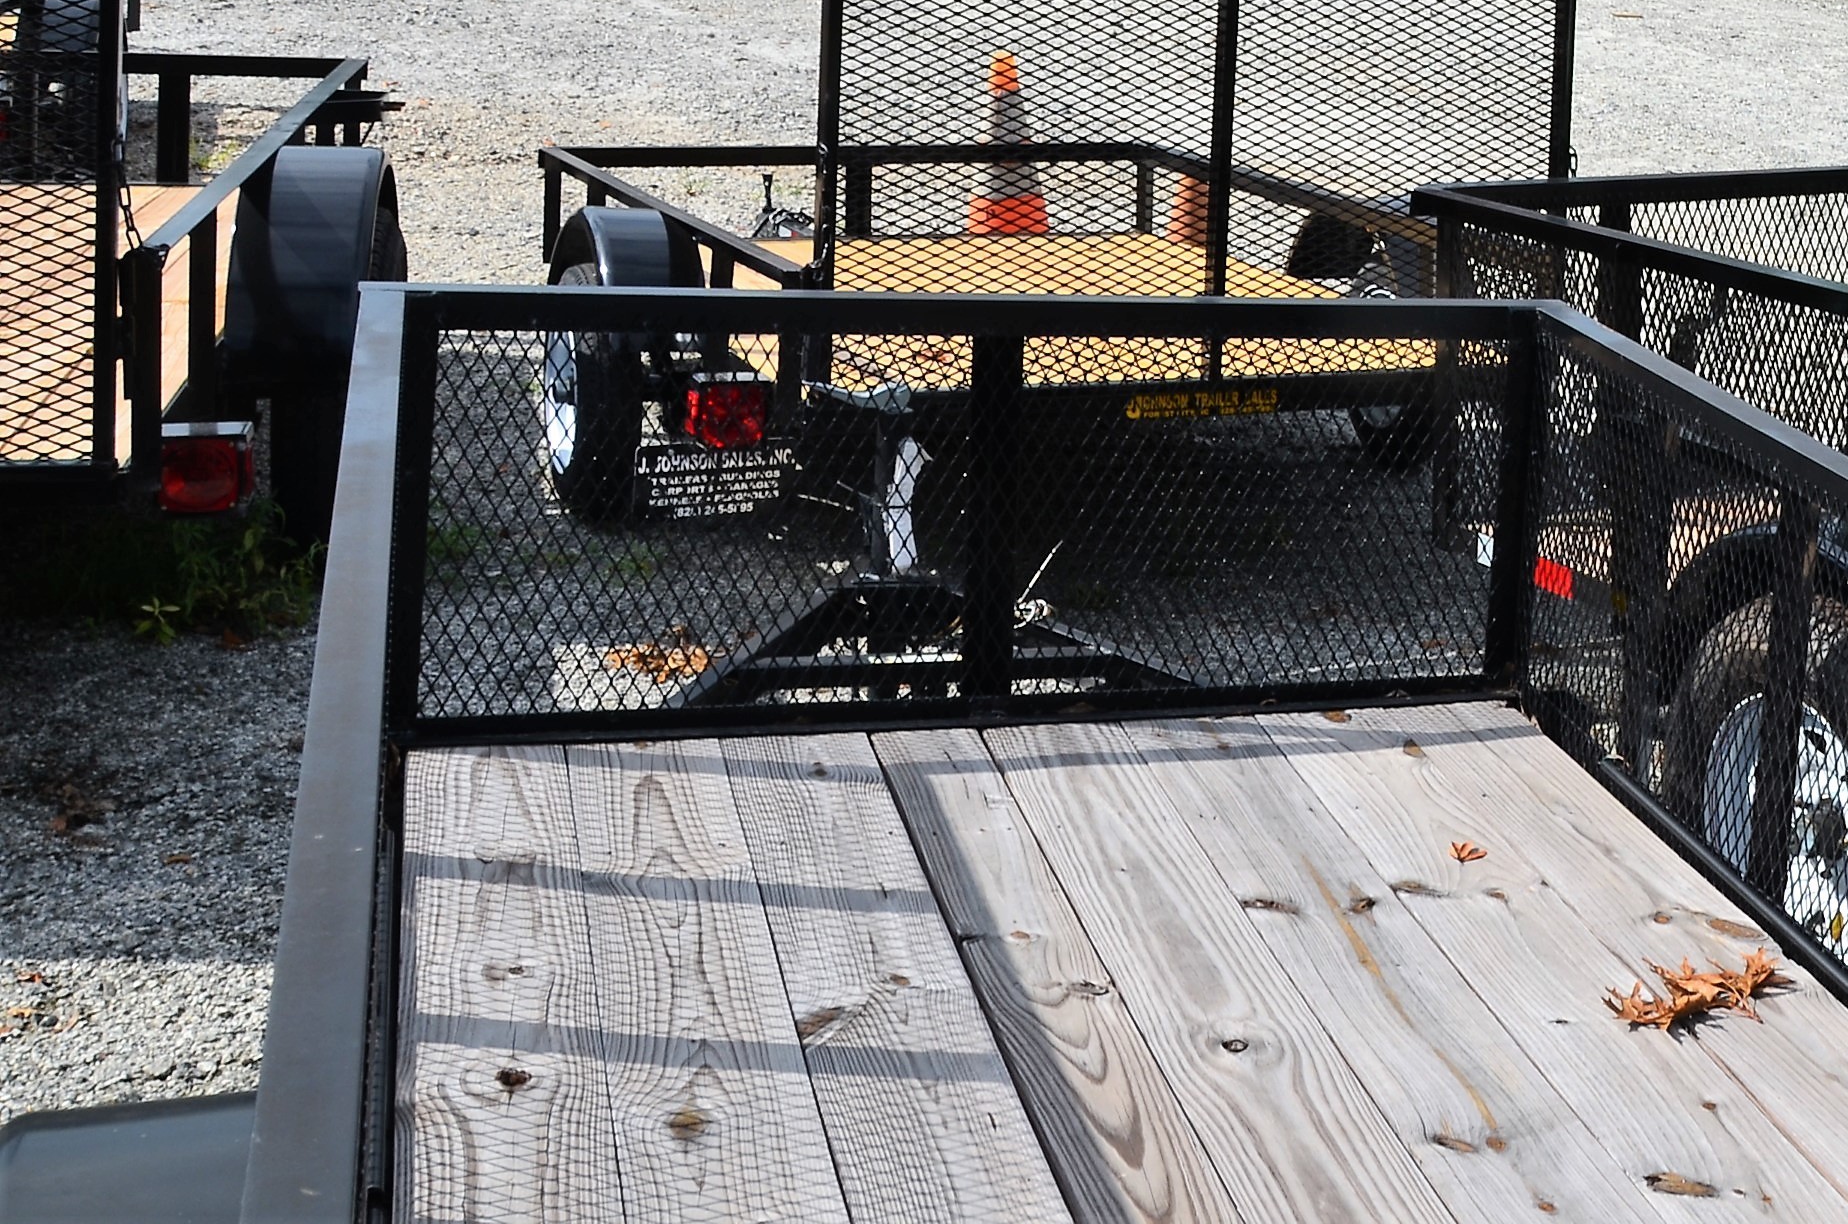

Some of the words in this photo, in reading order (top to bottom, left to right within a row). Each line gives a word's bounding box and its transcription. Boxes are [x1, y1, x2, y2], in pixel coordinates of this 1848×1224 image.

[655, 453, 717, 473] JOHNSON
[719, 470, 780, 481] BUDIGS
[652, 486, 713, 496] CRPORTS
[726, 480, 778, 491] ARGES
[649, 496, 702, 506] KENNES
[714, 490, 779, 502] FAGOLES
[704, 503, 753, 515] 25-595
